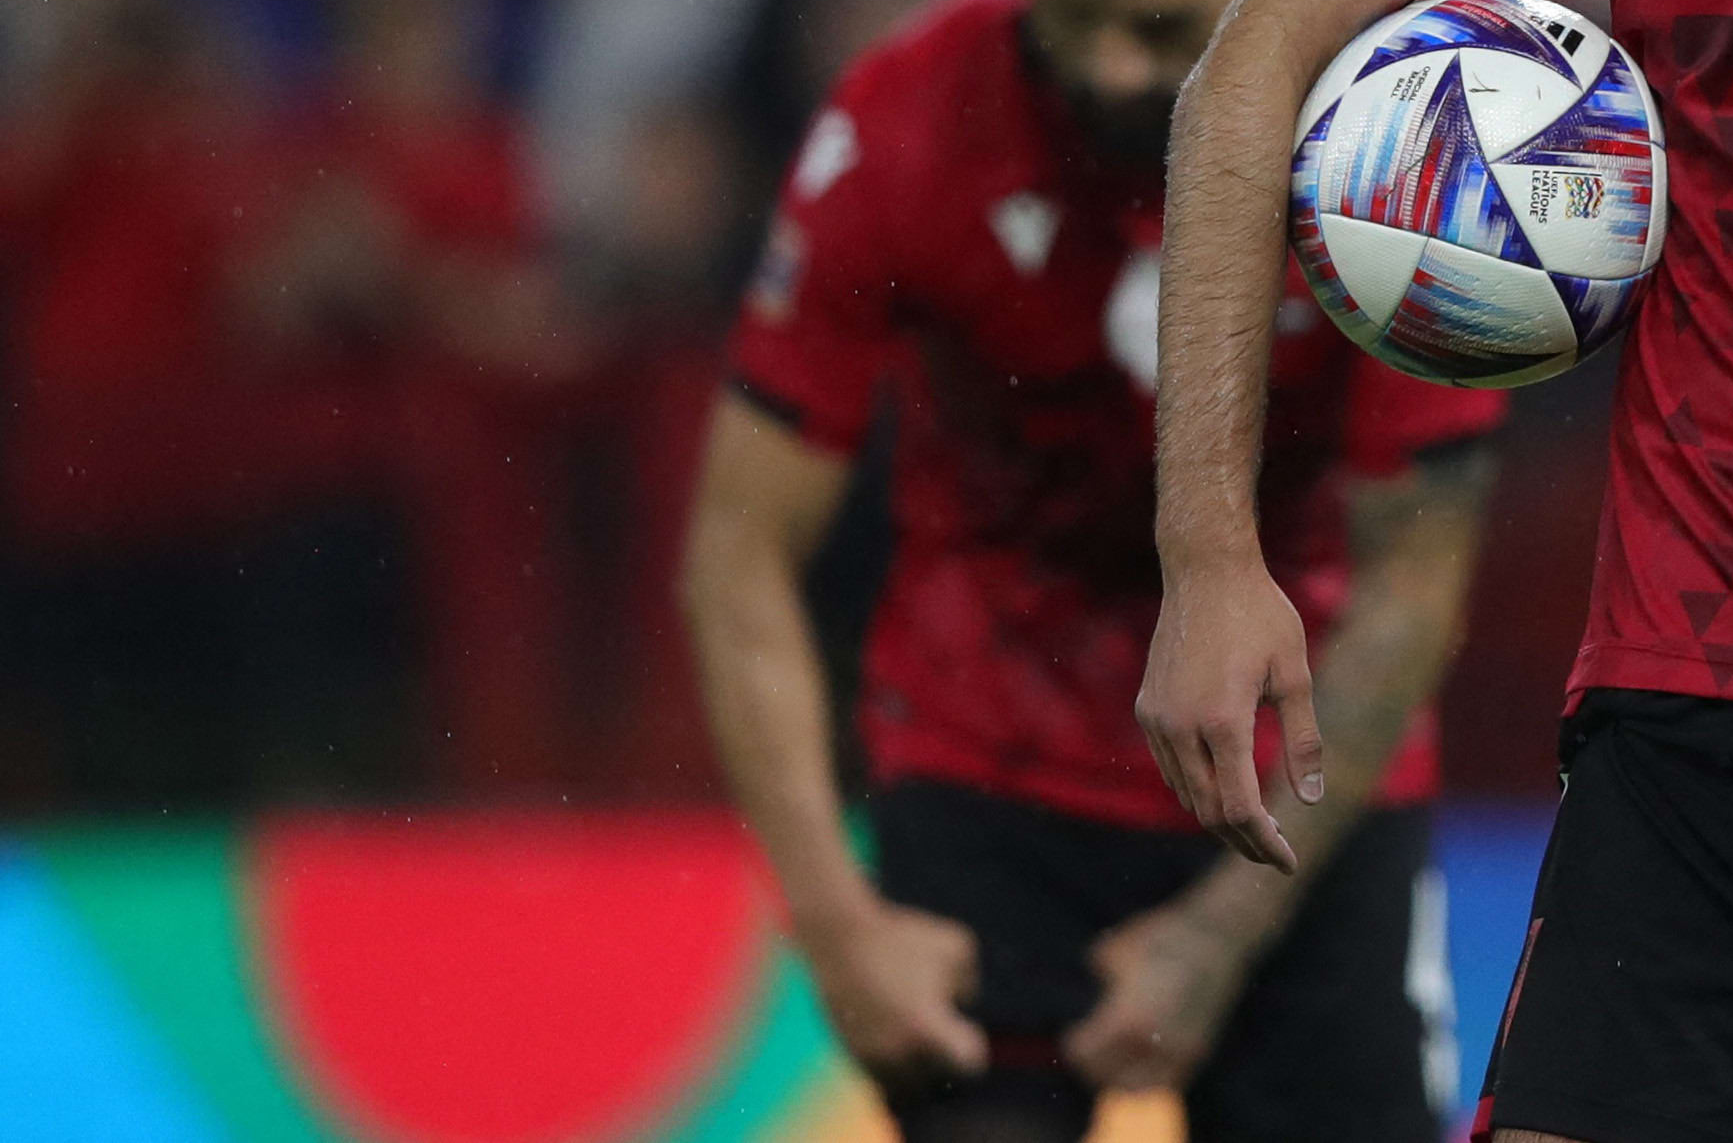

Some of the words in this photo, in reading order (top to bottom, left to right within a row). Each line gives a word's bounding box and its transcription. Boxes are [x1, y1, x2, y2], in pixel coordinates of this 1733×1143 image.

[1390, 78, 1405, 98] BALL
[1399, 71, 1420, 101] MATCH
[1529, 170, 1541, 217] LEAGUE
[1538, 170, 1551, 224] NATIONS
[1550, 176, 1558, 199] UEFA
